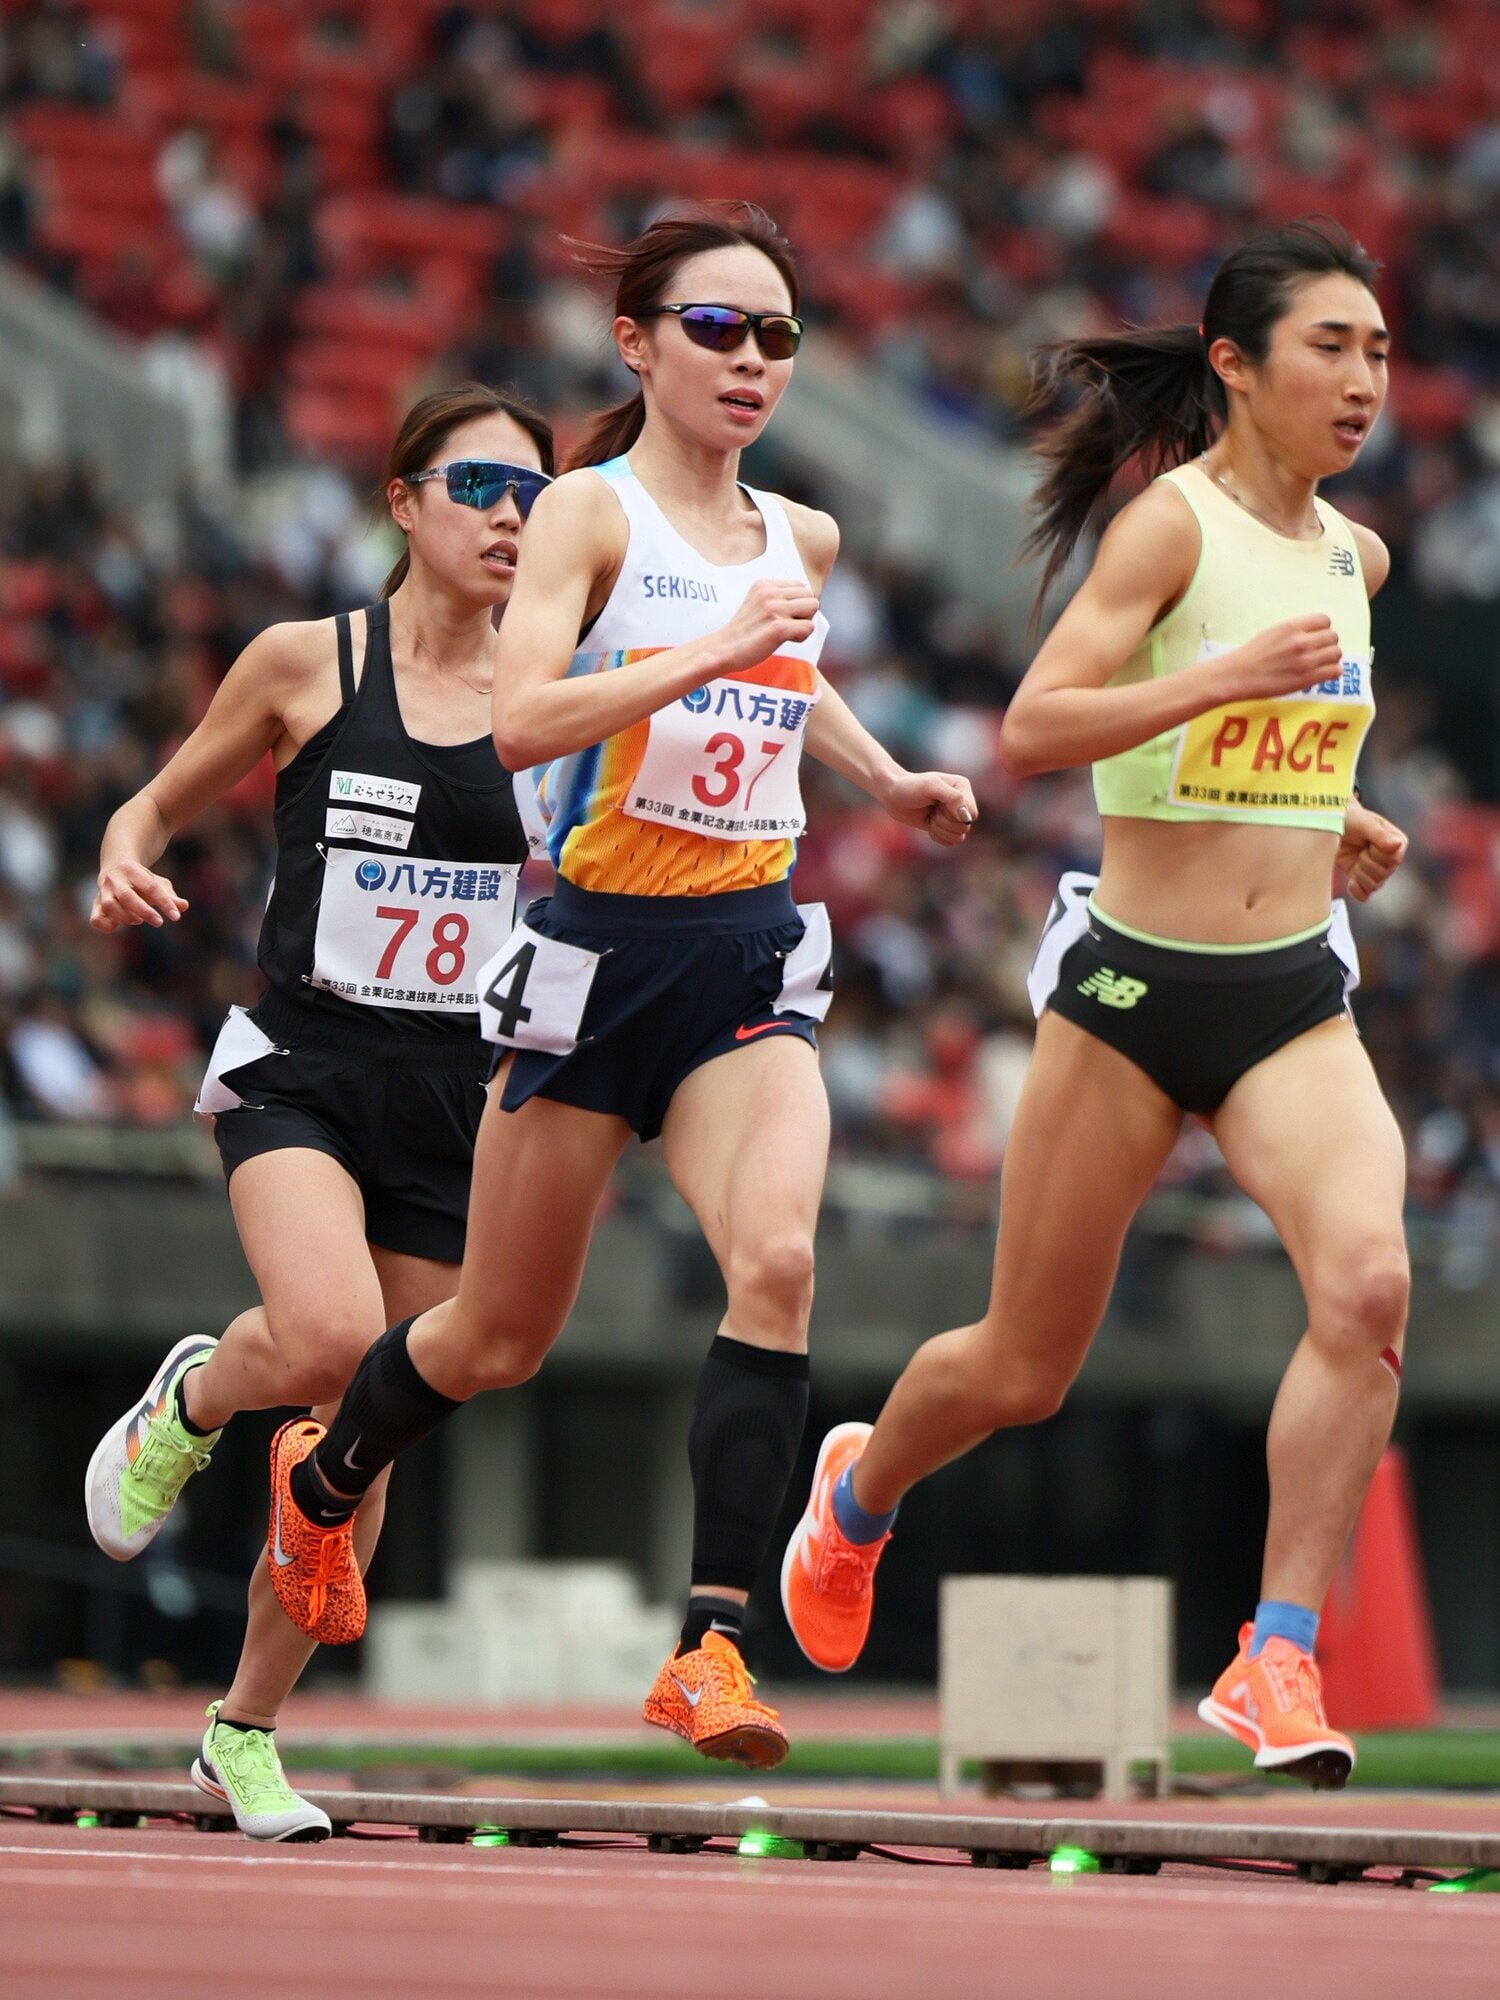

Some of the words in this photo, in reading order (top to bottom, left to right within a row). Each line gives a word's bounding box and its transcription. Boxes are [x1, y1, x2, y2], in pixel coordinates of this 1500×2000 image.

[643, 575, 718, 603] SEKISUI
[1210, 715, 1350, 774] PACE
[691, 731, 786, 812] 37
[354, 785, 414, 806] むらせライス
[634, 797, 675, 817] 第33回
[1179, 784, 1220, 800] 第33回
[387, 863, 502, 902] 八方建設
[375, 905, 470, 986] 78
[483, 940, 538, 1040] 4
